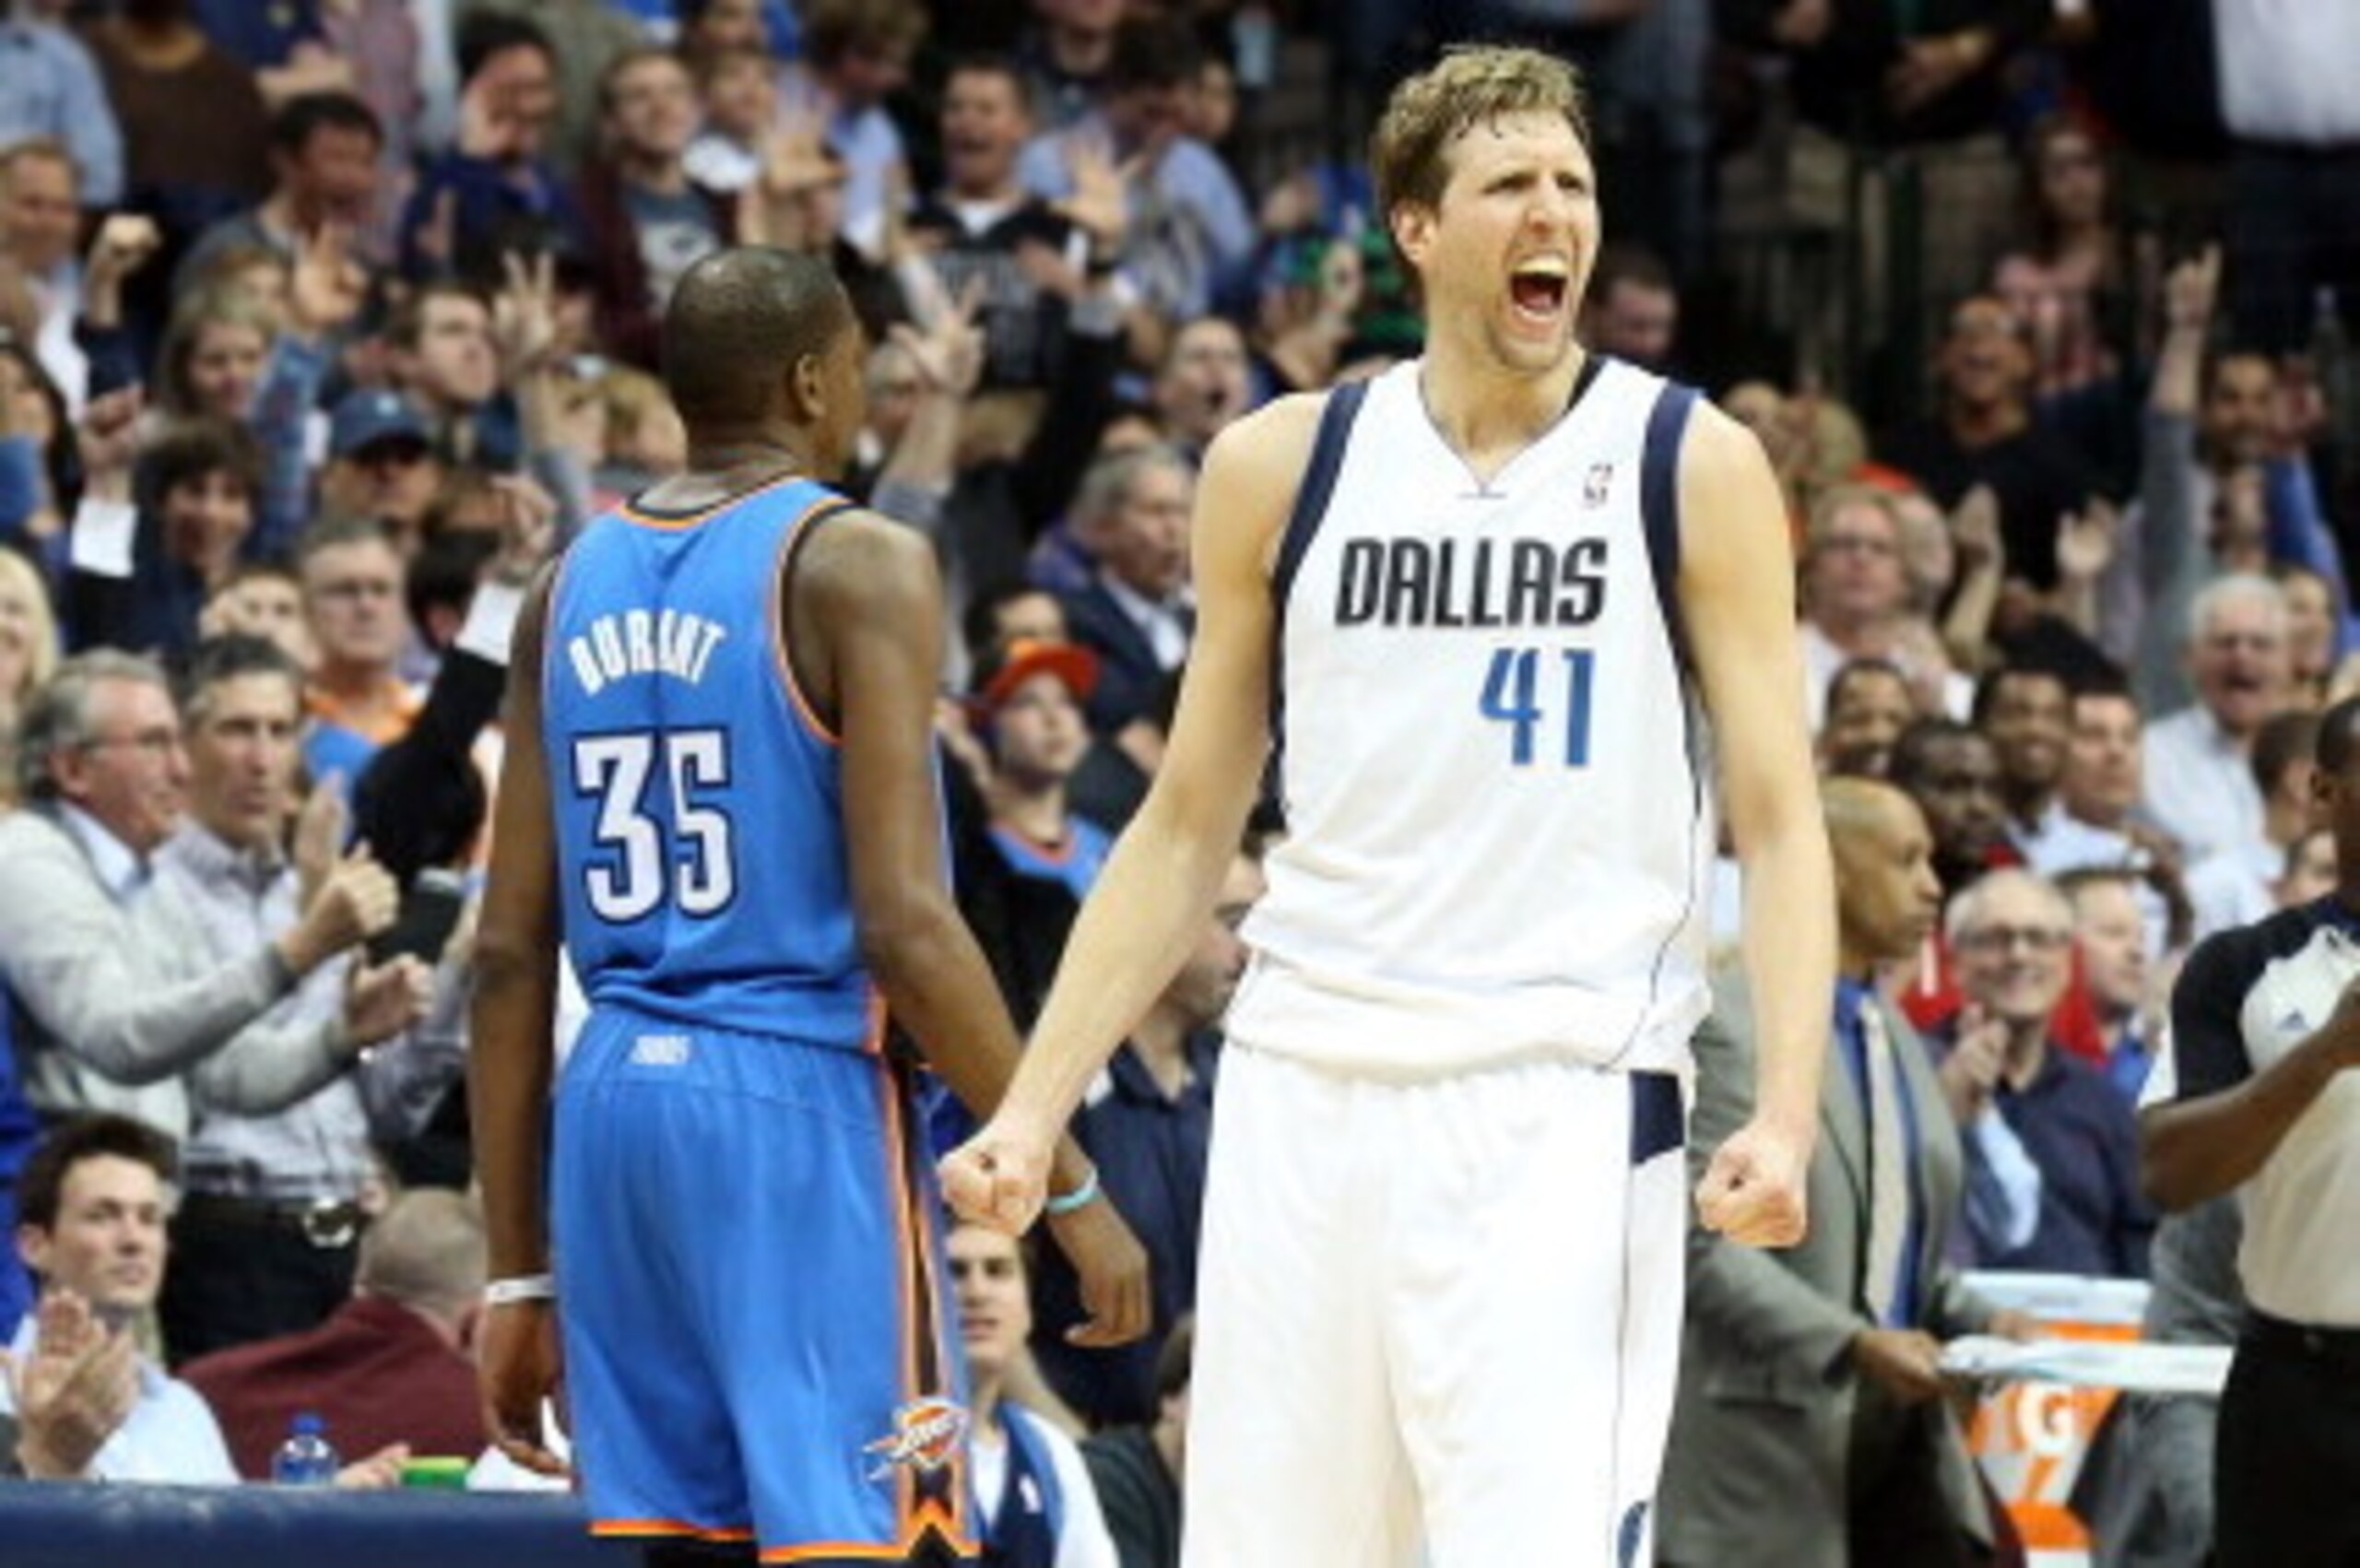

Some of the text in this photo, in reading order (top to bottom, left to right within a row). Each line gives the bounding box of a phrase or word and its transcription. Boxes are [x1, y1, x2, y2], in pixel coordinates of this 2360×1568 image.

[1334, 536, 1609, 629] DALLAS
[1478, 646, 1596, 767] 41
[572, 727, 737, 925] 35
